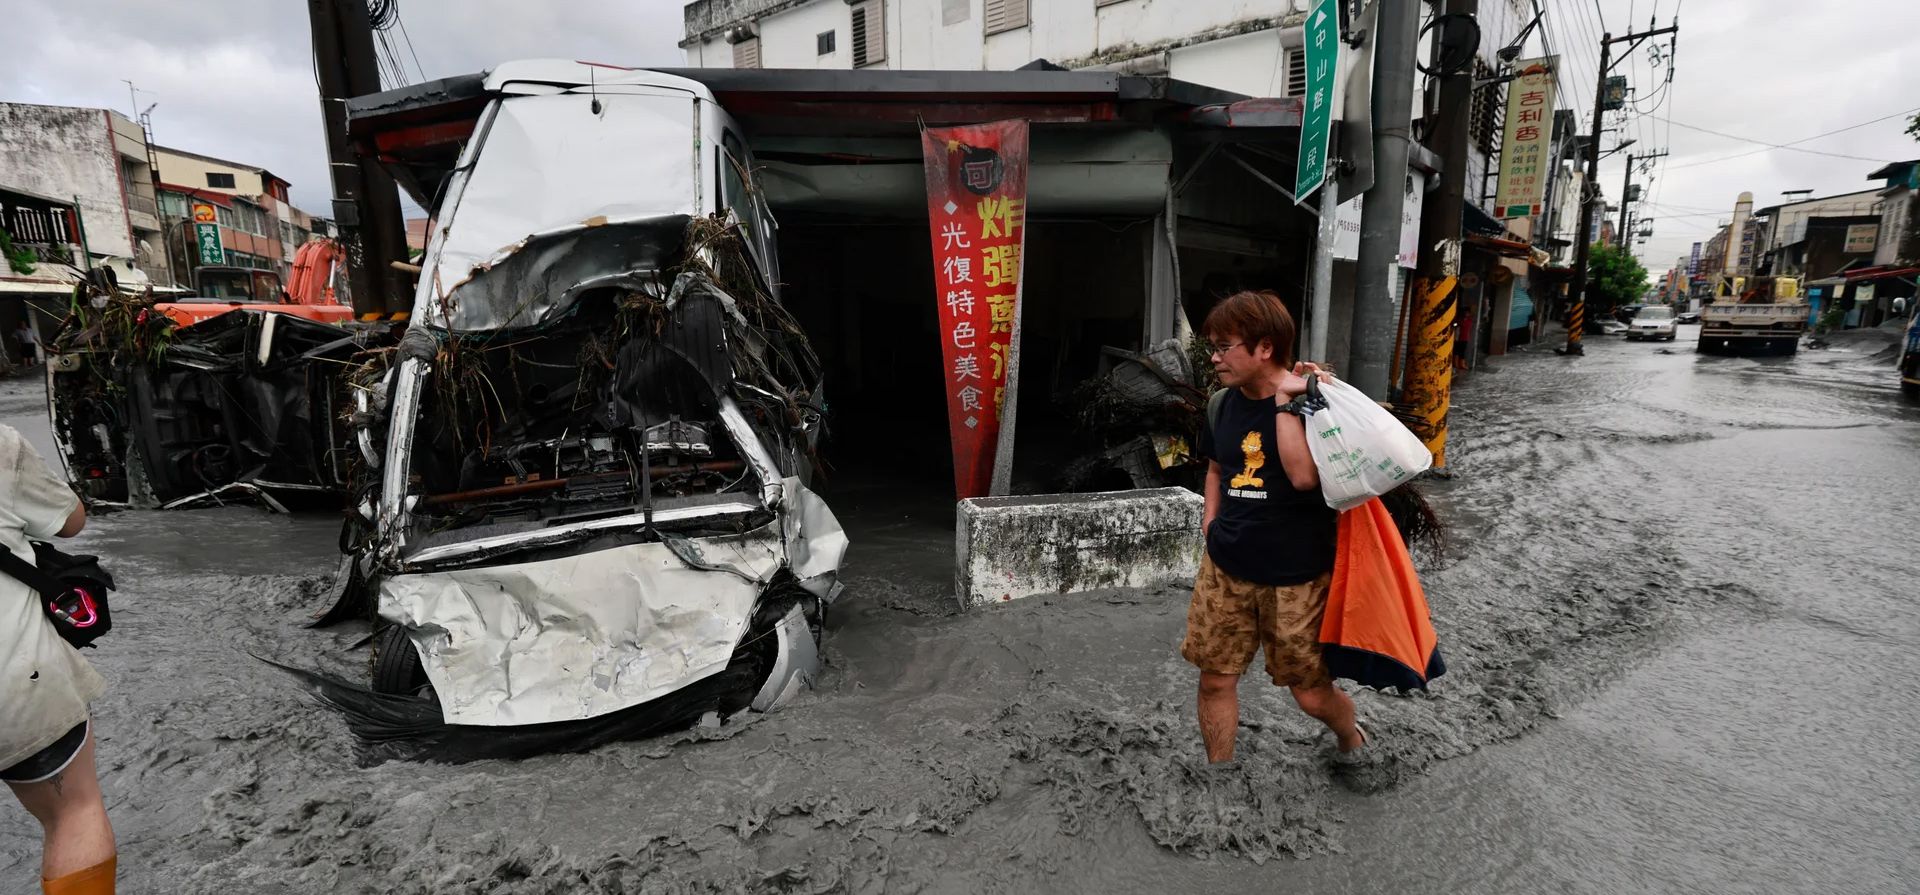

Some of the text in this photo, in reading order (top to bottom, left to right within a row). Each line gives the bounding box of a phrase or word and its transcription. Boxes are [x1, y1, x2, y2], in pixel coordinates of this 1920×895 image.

[1306, 29, 1327, 171] 中山路二段
[1515, 91, 1544, 141] 吉利香
[965, 160, 993, 188] 可
[941, 221, 983, 412] 光復特色美食
[976, 195, 1024, 421] 炸彈蔥
[1241, 490, 1268, 499] MONDAYS
